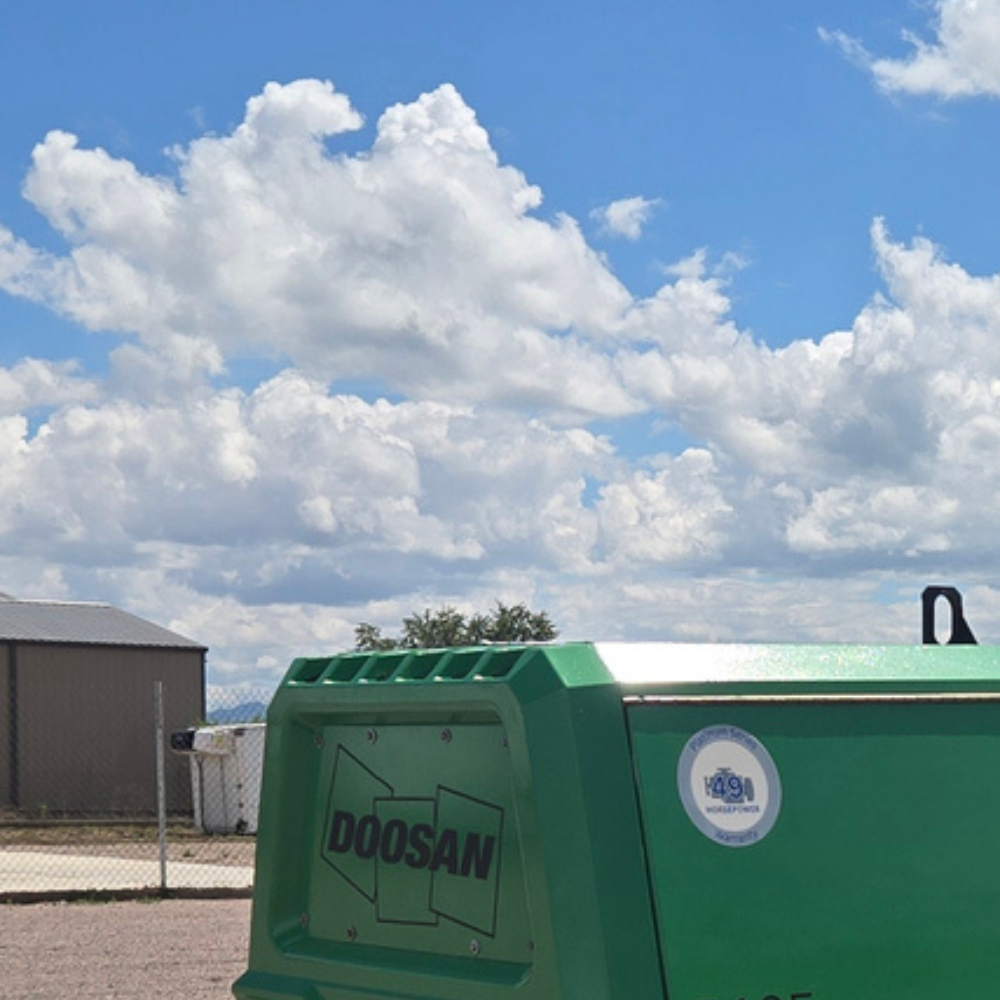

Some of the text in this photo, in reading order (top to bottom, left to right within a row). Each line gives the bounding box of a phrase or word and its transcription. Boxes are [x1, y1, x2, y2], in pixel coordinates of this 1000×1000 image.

[711, 776, 744, 800] 49
[705, 804, 761, 814] HORSEPOWER
[327, 809, 496, 881] DOOSAN
